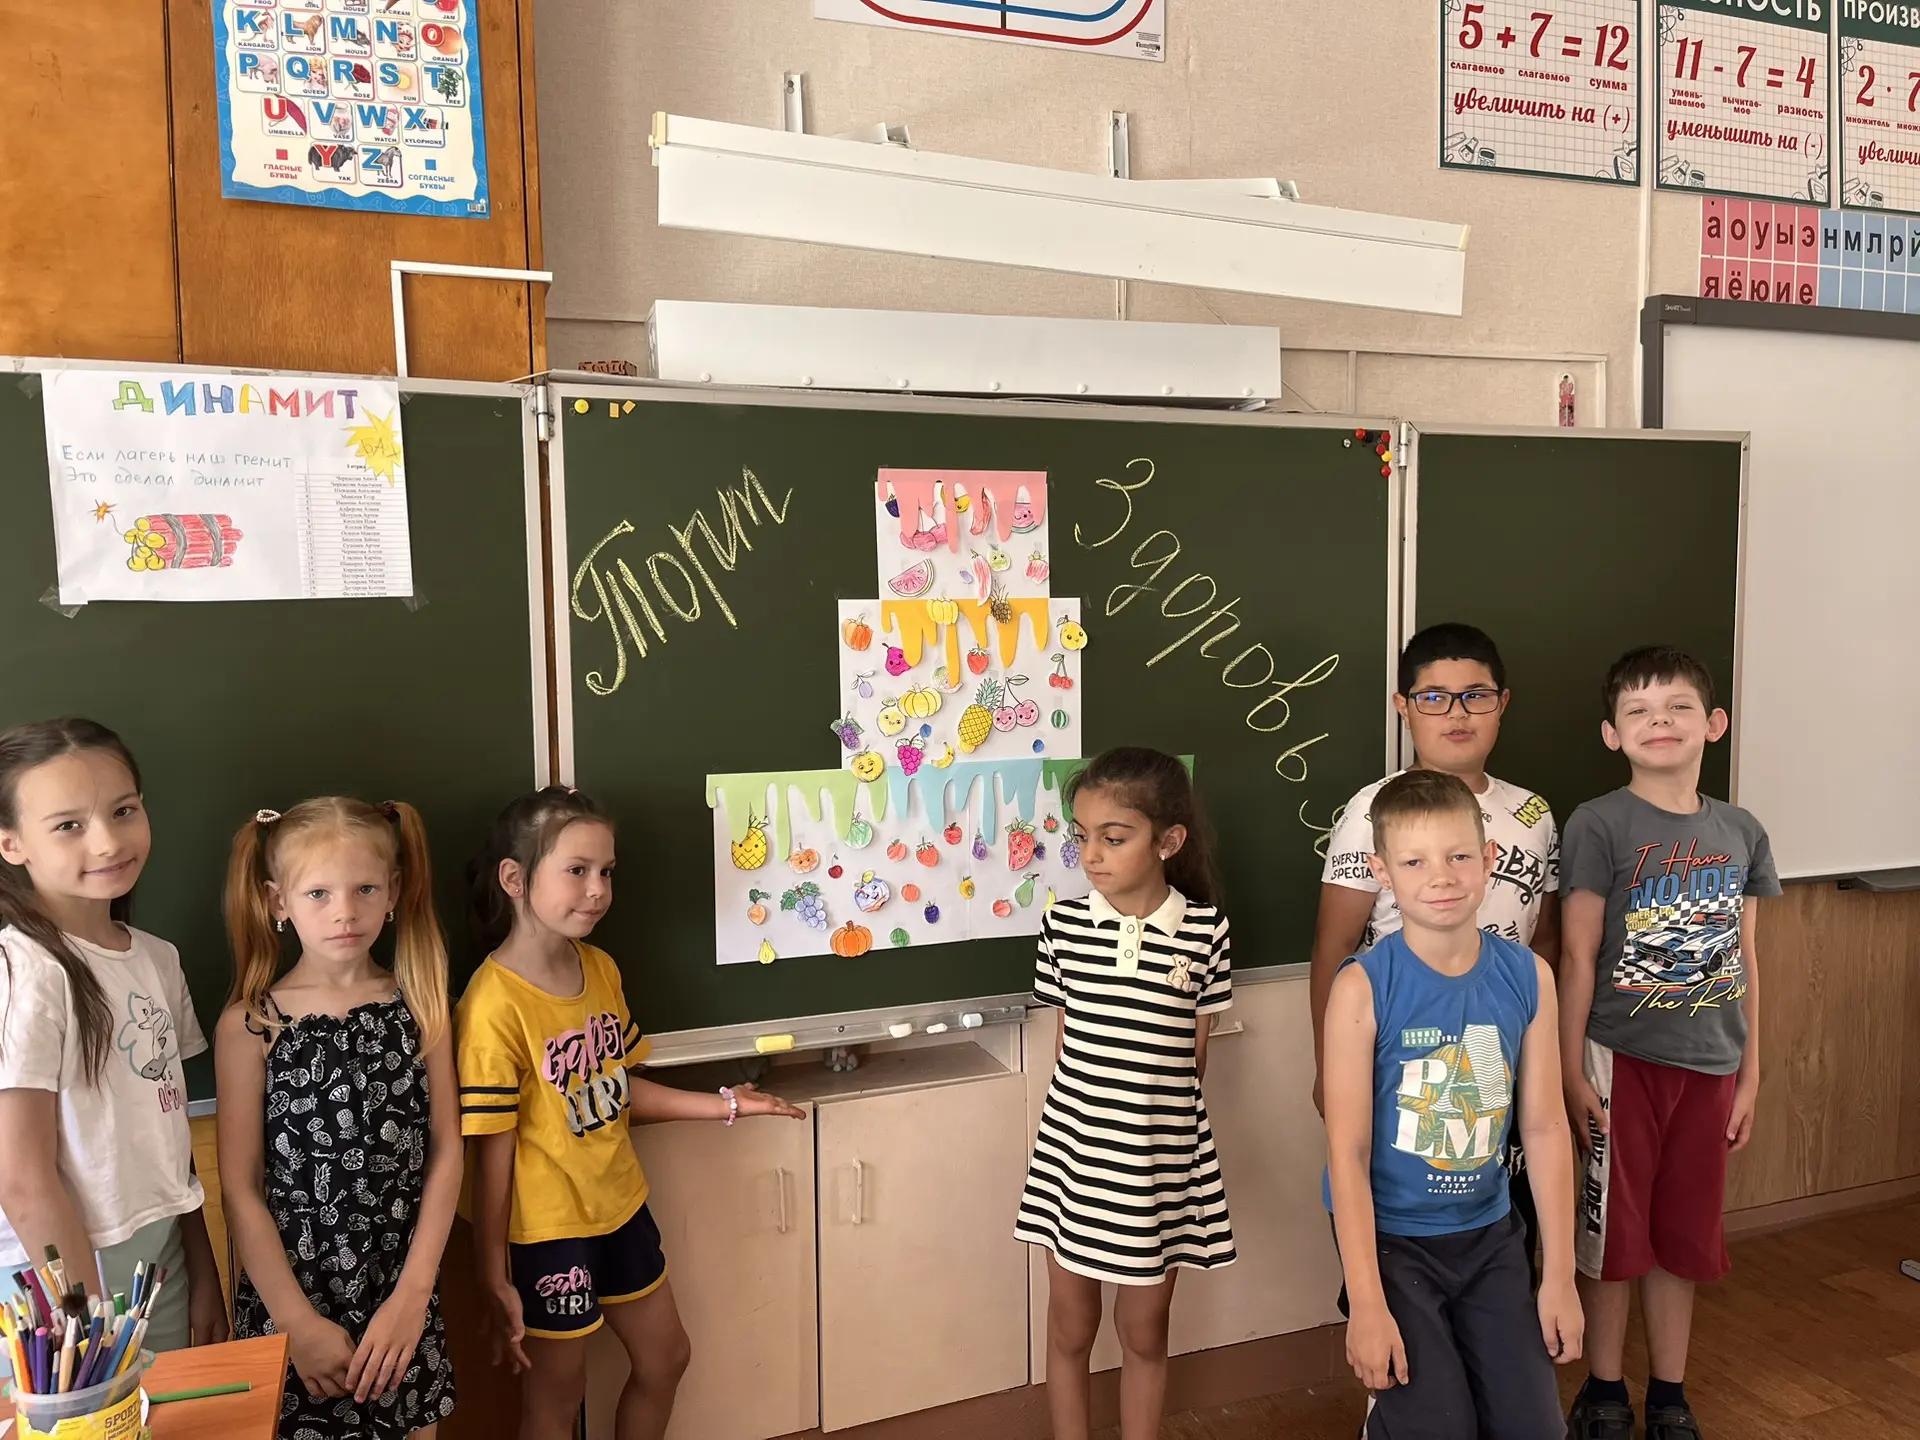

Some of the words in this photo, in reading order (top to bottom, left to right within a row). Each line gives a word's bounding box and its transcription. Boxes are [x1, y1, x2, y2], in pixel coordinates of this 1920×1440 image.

[236, 9, 260, 32] K
[1705, 0, 1821, 22] ОСТЬ
[284, 13, 304, 35] L
[330, 17, 356, 39] M
[376, 20, 398, 42] N
[421, 23, 443, 45] O
[1459, 3, 1484, 49] 5
[1496, 27, 1516, 49] +
[1530, 12, 1554, 58] 7
[1562, 35, 1583, 58] =
[1594, 23, 1630, 71] 12
[239, 53, 259, 75] P
[286, 56, 310, 80] Q
[333, 60, 355, 82] R
[380, 63, 399, 85] S
[1675, 37, 1703, 81] 11
[1737, 45, 1757, 88] 7
[1766, 68, 1785, 88] =
[1796, 56, 1816, 99] 4
[424, 67, 444, 88] T
[1450, 61, 1505, 75] слагаемое
[1518, 69, 1571, 83] слагаемое
[1589, 77, 1628, 91] сумма
[1671, 88, 1703, 99] умень-
[1856, 65, 1875, 107] 2
[1908, 72, 1920, 112] 7
[264, 98, 286, 120] U
[312, 101, 336, 124] V
[1453, 87, 1566, 120] увеличить
[1571, 106, 1596, 124] на
[1603, 104, 1631, 134] (+)
[1669, 98, 1706, 110] шаемое
[1722, 96, 1762, 108] вычитае-
[1733, 106, 1751, 115] мое
[1777, 103, 1824, 120] разность
[357, 104, 388, 127] W
[403, 107, 426, 129] X
[1846, 116, 1890, 128] множитель
[1666, 119, 1773, 147] уменьшить
[1777, 133, 1798, 151] на
[1804, 133, 1823, 160] (-)
[313, 144, 338, 167] Y
[361, 148, 383, 169] Z
[263, 163, 302, 172] ГЛАСНЫЕ
[270, 172, 298, 180] БУКВЫ
[408, 174, 455, 182] СОГЛАСНЫЕ
[112, 380, 358, 419] ДИНАМИТ
[62, 444, 105, 461] Если
[115, 450, 176, 463] лагерь
[235, 454, 292, 468] гремит
[66, 466, 97, 482] Это
[115, 466, 174, 486] сделал
[190, 469, 265, 487] динамит
[571, 464, 793, 695] Торт
[1332, 851, 1368, 868] EVERYD
[1624, 842, 1662, 892] I
[1660, 837, 1731, 881] Have
[1331, 866, 1374, 880] SPECIA
[1629, 873, 1680, 910] NO
[1625, 910, 1657, 922] WHERE
[1629, 981, 1688, 1018] The
[1405, 1030, 1442, 1039] SUMMER
[1427, 1173, 1481, 1182] SPRINGS
[546, 1292, 594, 1315] GIRL
